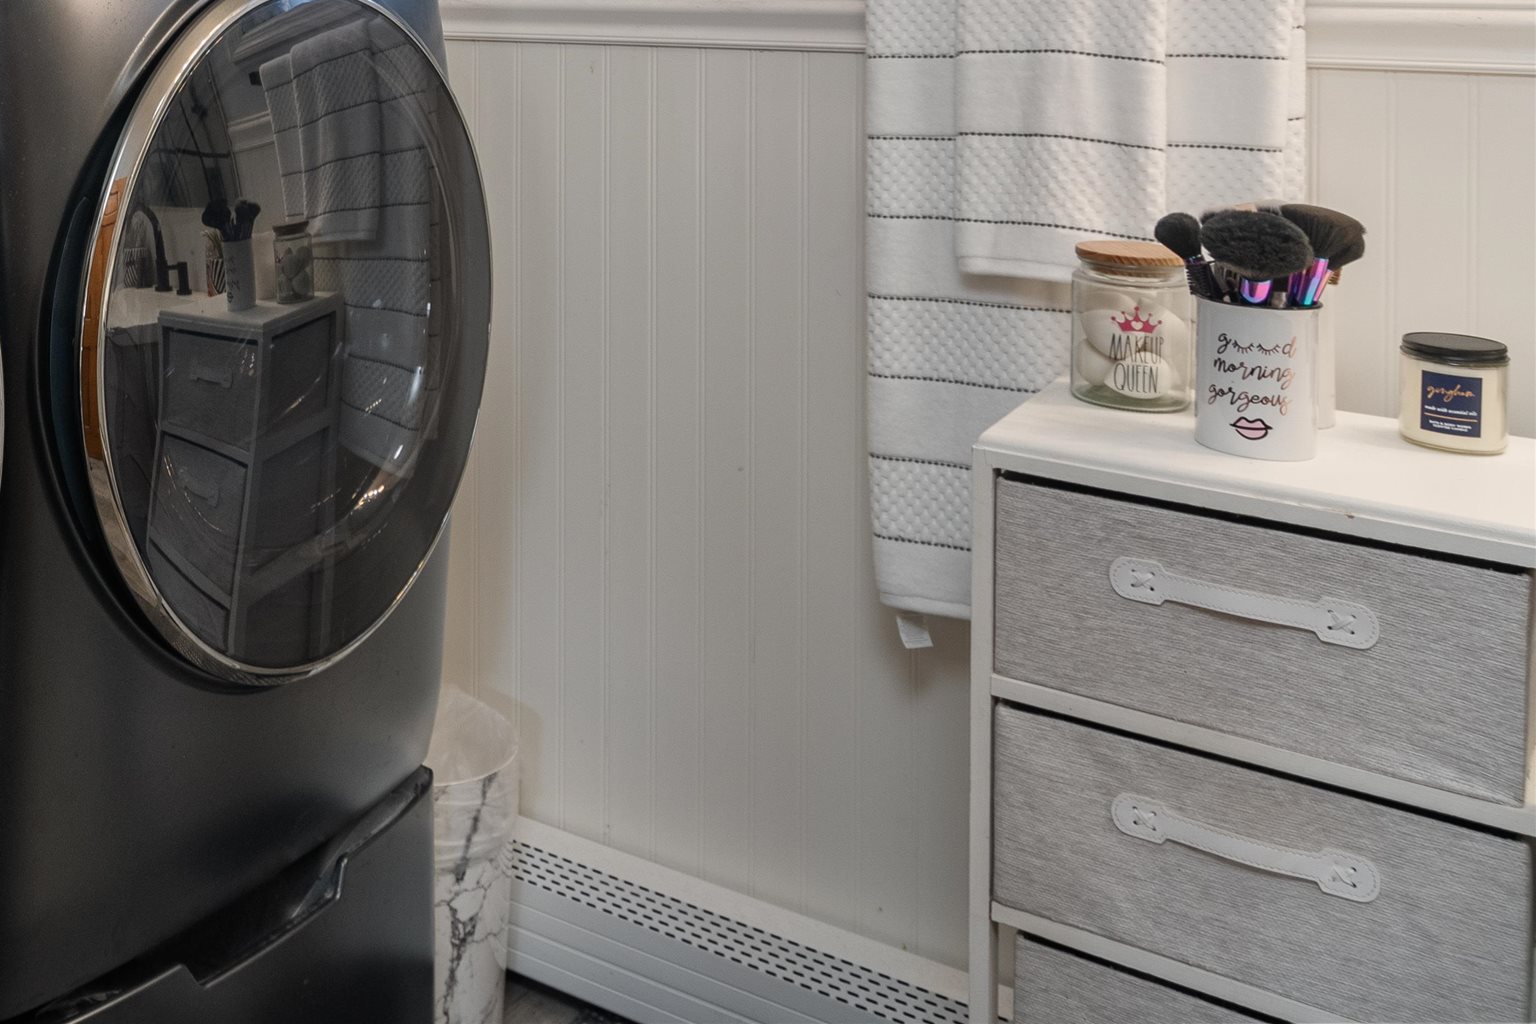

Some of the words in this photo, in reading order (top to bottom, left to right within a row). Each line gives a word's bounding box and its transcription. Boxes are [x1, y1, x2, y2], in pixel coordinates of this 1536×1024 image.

[1110, 333, 1164, 364] MAKEUP
[1214, 357, 1295, 390] morning
[1208, 383, 1293, 415] gorgeous
